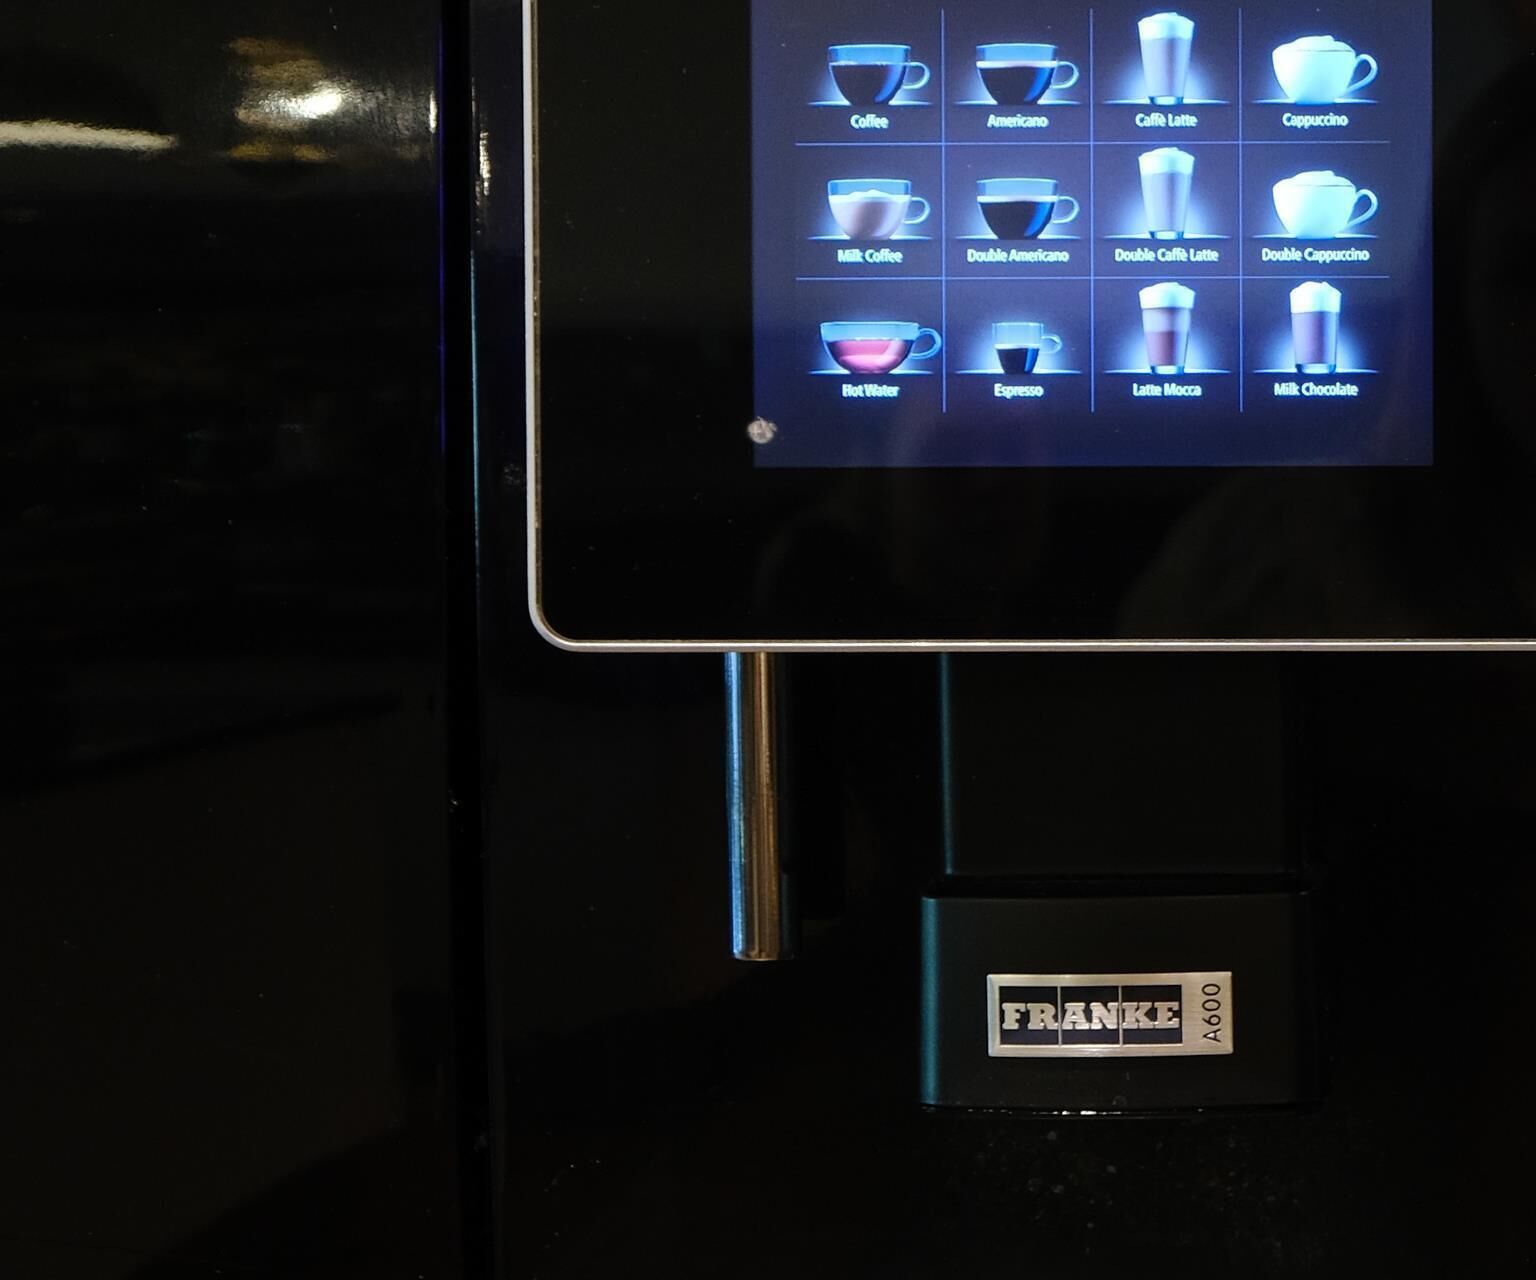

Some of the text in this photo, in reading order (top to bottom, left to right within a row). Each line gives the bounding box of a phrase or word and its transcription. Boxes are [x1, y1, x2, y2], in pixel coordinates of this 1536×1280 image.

[850, 114, 889, 128] Coffee
[987, 114, 1049, 128] Americano
[1135, 113, 1198, 128] Caffè Latte
[1282, 113, 1349, 129] Cappuccino
[837, 249, 903, 263] Milk Coffee
[967, 248, 1069, 263] Double Americano
[1115, 248, 1218, 262] Double Caffè Latte
[1261, 248, 1370, 264] Double Cappuccino
[842, 384, 900, 398] Hot Water
[994, 384, 1044, 400] Espresso
[1133, 383, 1202, 397] Latte Mocca
[1274, 382, 1358, 397] Milk Chocolate
[1001, 1002, 1180, 1031] FRANKE
[1201, 982, 1222, 1043] A600
